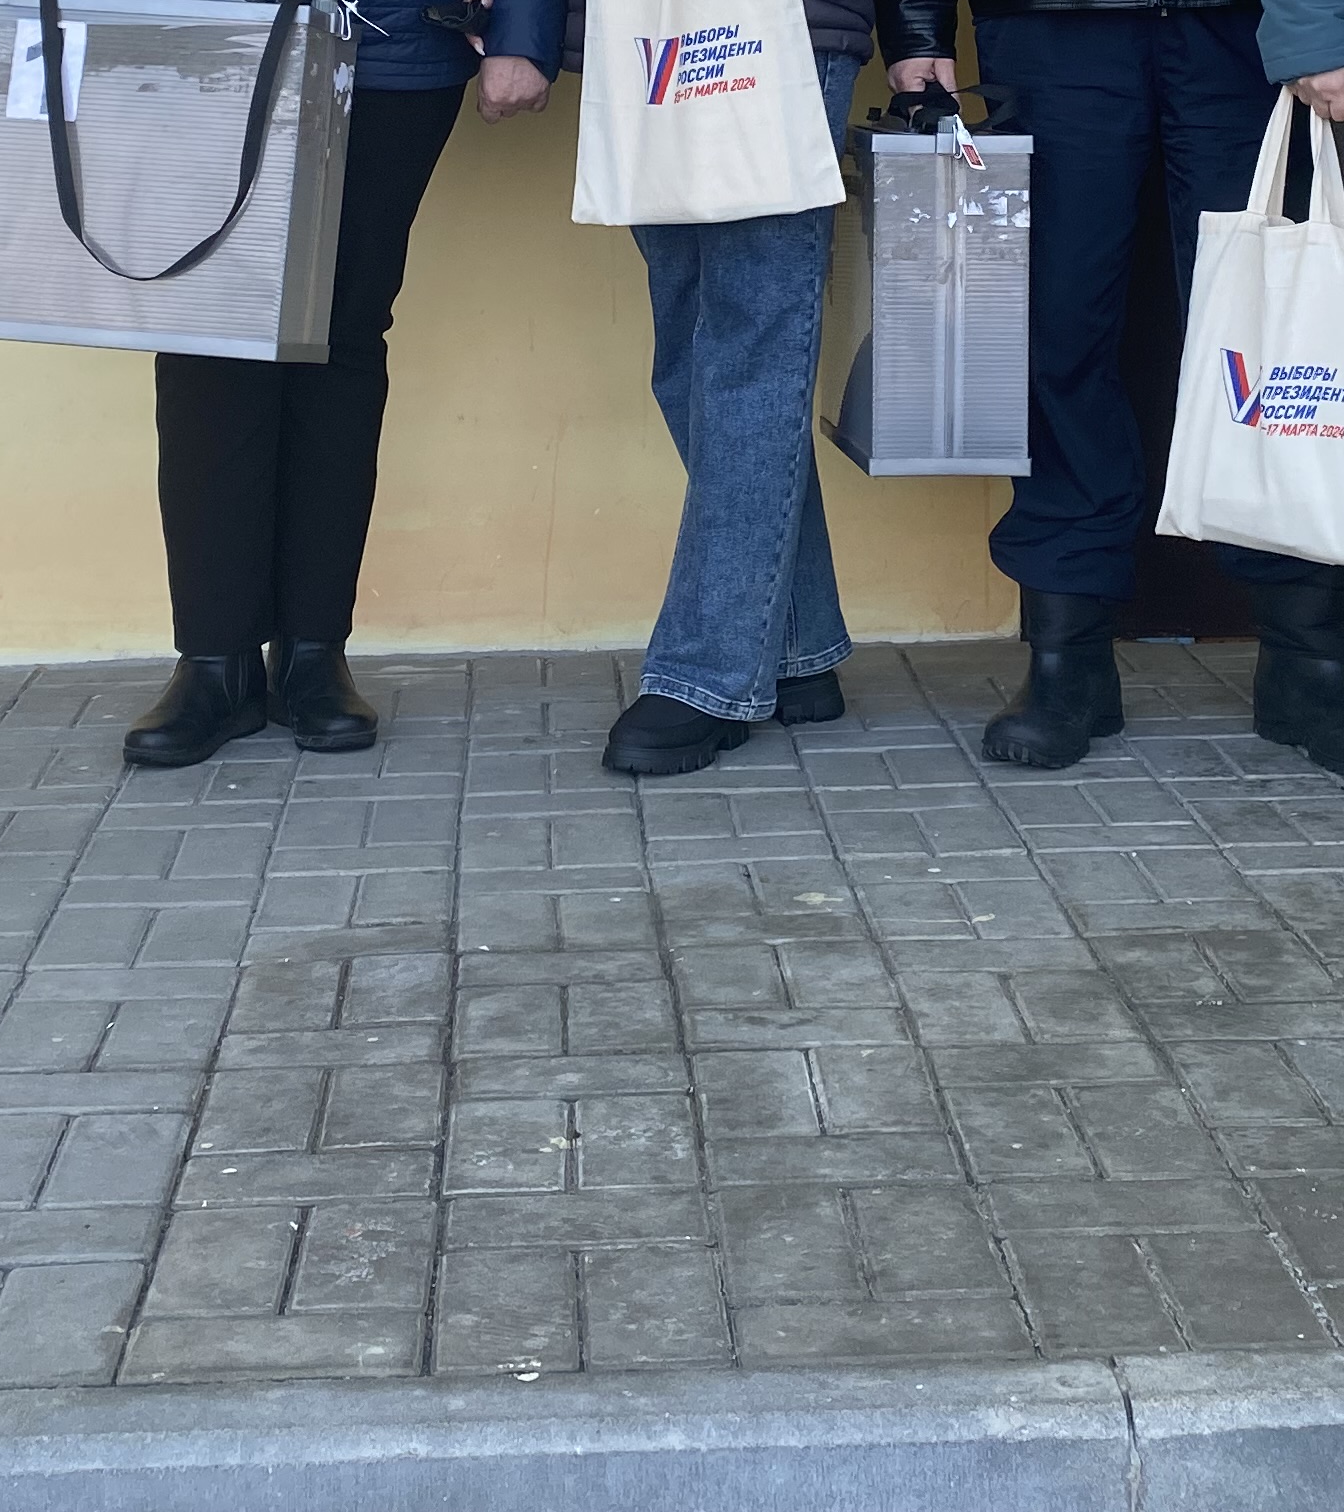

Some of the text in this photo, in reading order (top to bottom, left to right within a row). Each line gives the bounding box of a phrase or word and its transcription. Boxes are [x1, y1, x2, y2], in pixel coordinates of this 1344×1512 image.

[694, 80, 728, 98] МАРТА
[730, 76, 757, 92] 2024
[1268, 365, 1338, 382] ВЫБОРЫ
[1279, 424, 1319, 437] МАРТА
